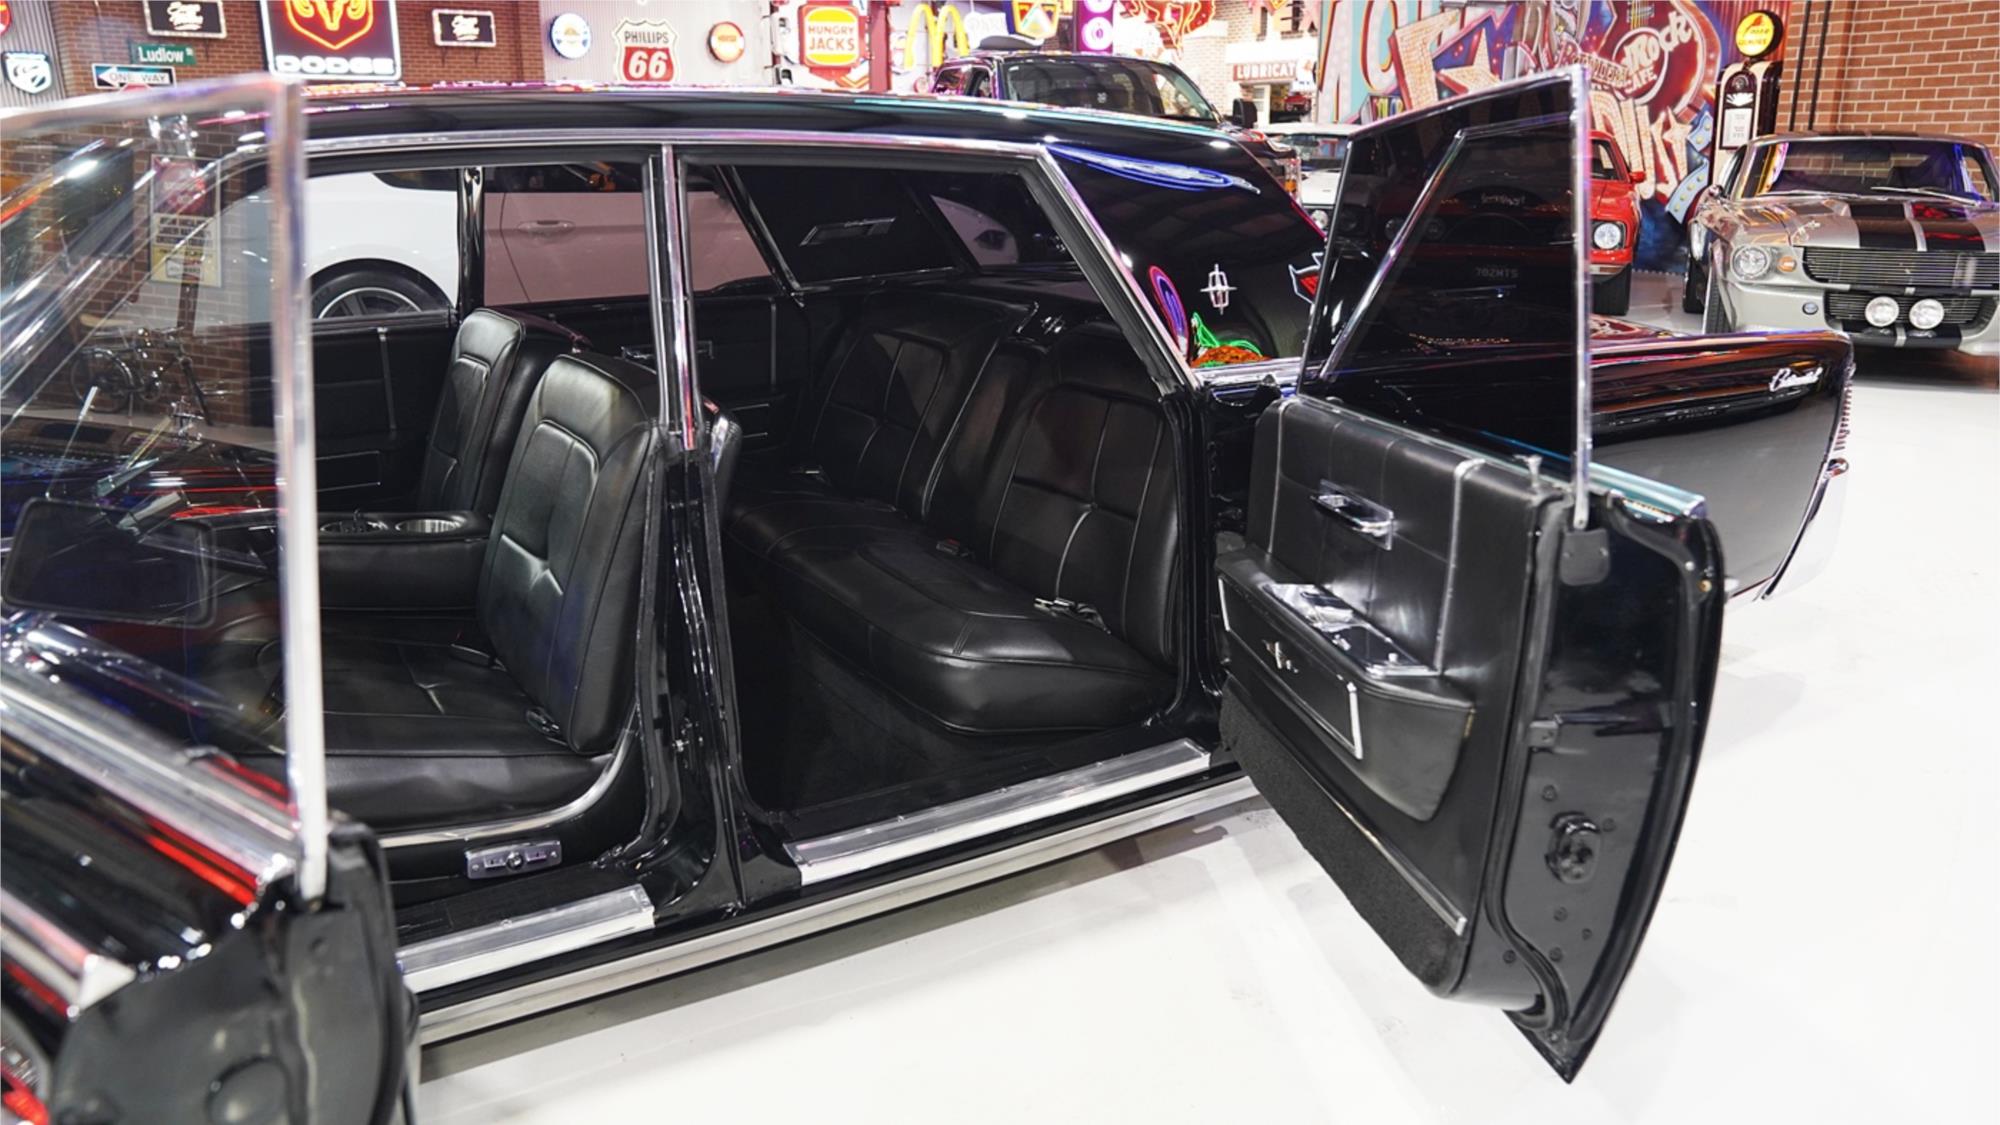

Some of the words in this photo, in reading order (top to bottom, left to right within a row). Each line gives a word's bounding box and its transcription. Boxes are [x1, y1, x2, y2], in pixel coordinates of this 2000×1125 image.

[624, 31, 669, 43] PHILLIPS
[808, 25, 854, 35] HUNGRY
[138, 46, 185, 62] Ludlow
[275, 55, 395, 75] DODGE
[629, 50, 668, 79] 66
[1237, 63, 1296, 79] LUBRICAT
[109, 72, 133, 81] ONE
[142, 73, 167, 82] WAY
